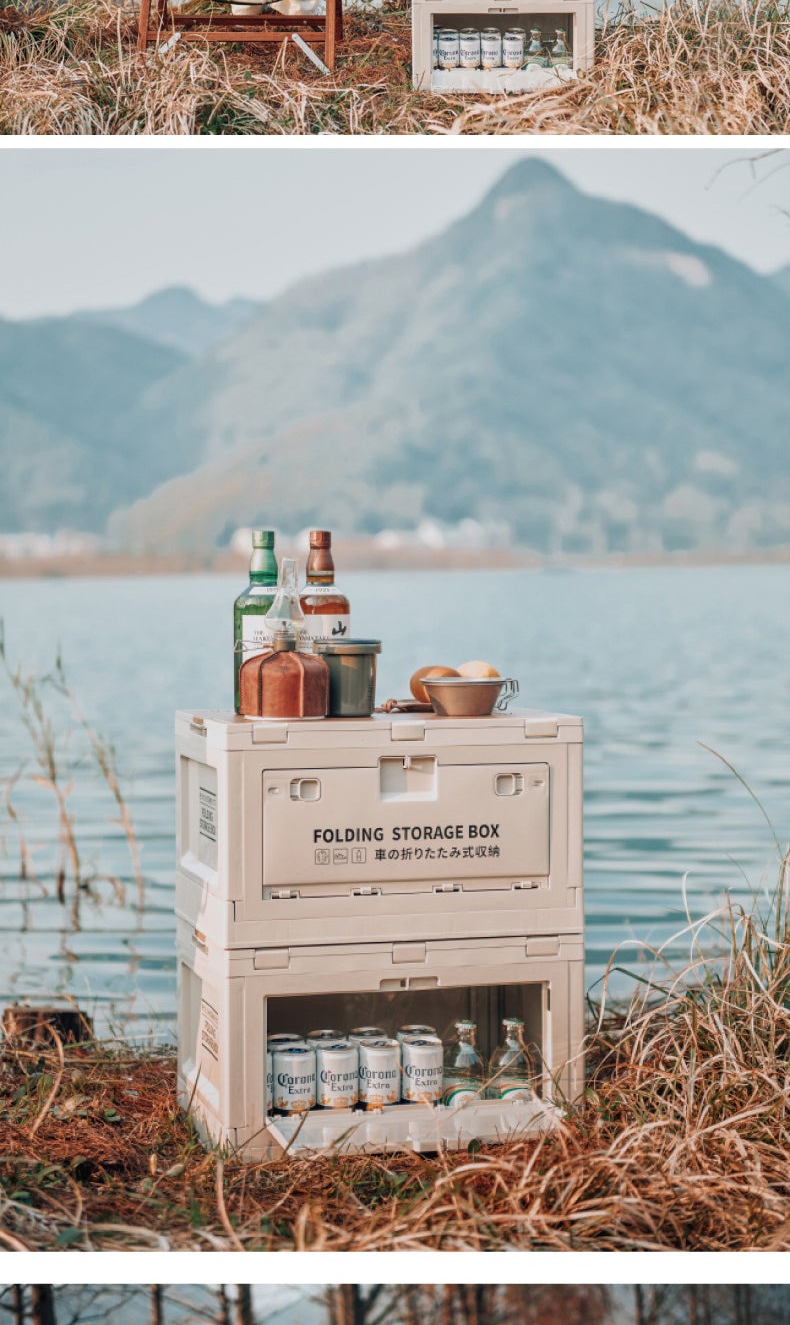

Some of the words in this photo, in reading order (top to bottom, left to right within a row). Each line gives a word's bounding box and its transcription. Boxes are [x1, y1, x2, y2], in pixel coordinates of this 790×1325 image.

[313, 827, 384, 843] FOLDING
[392, 825, 464, 841] STORAGE
[468, 823, 500, 839] BOX
[374, 845, 500, 861] 車の折りたたみ式収納
